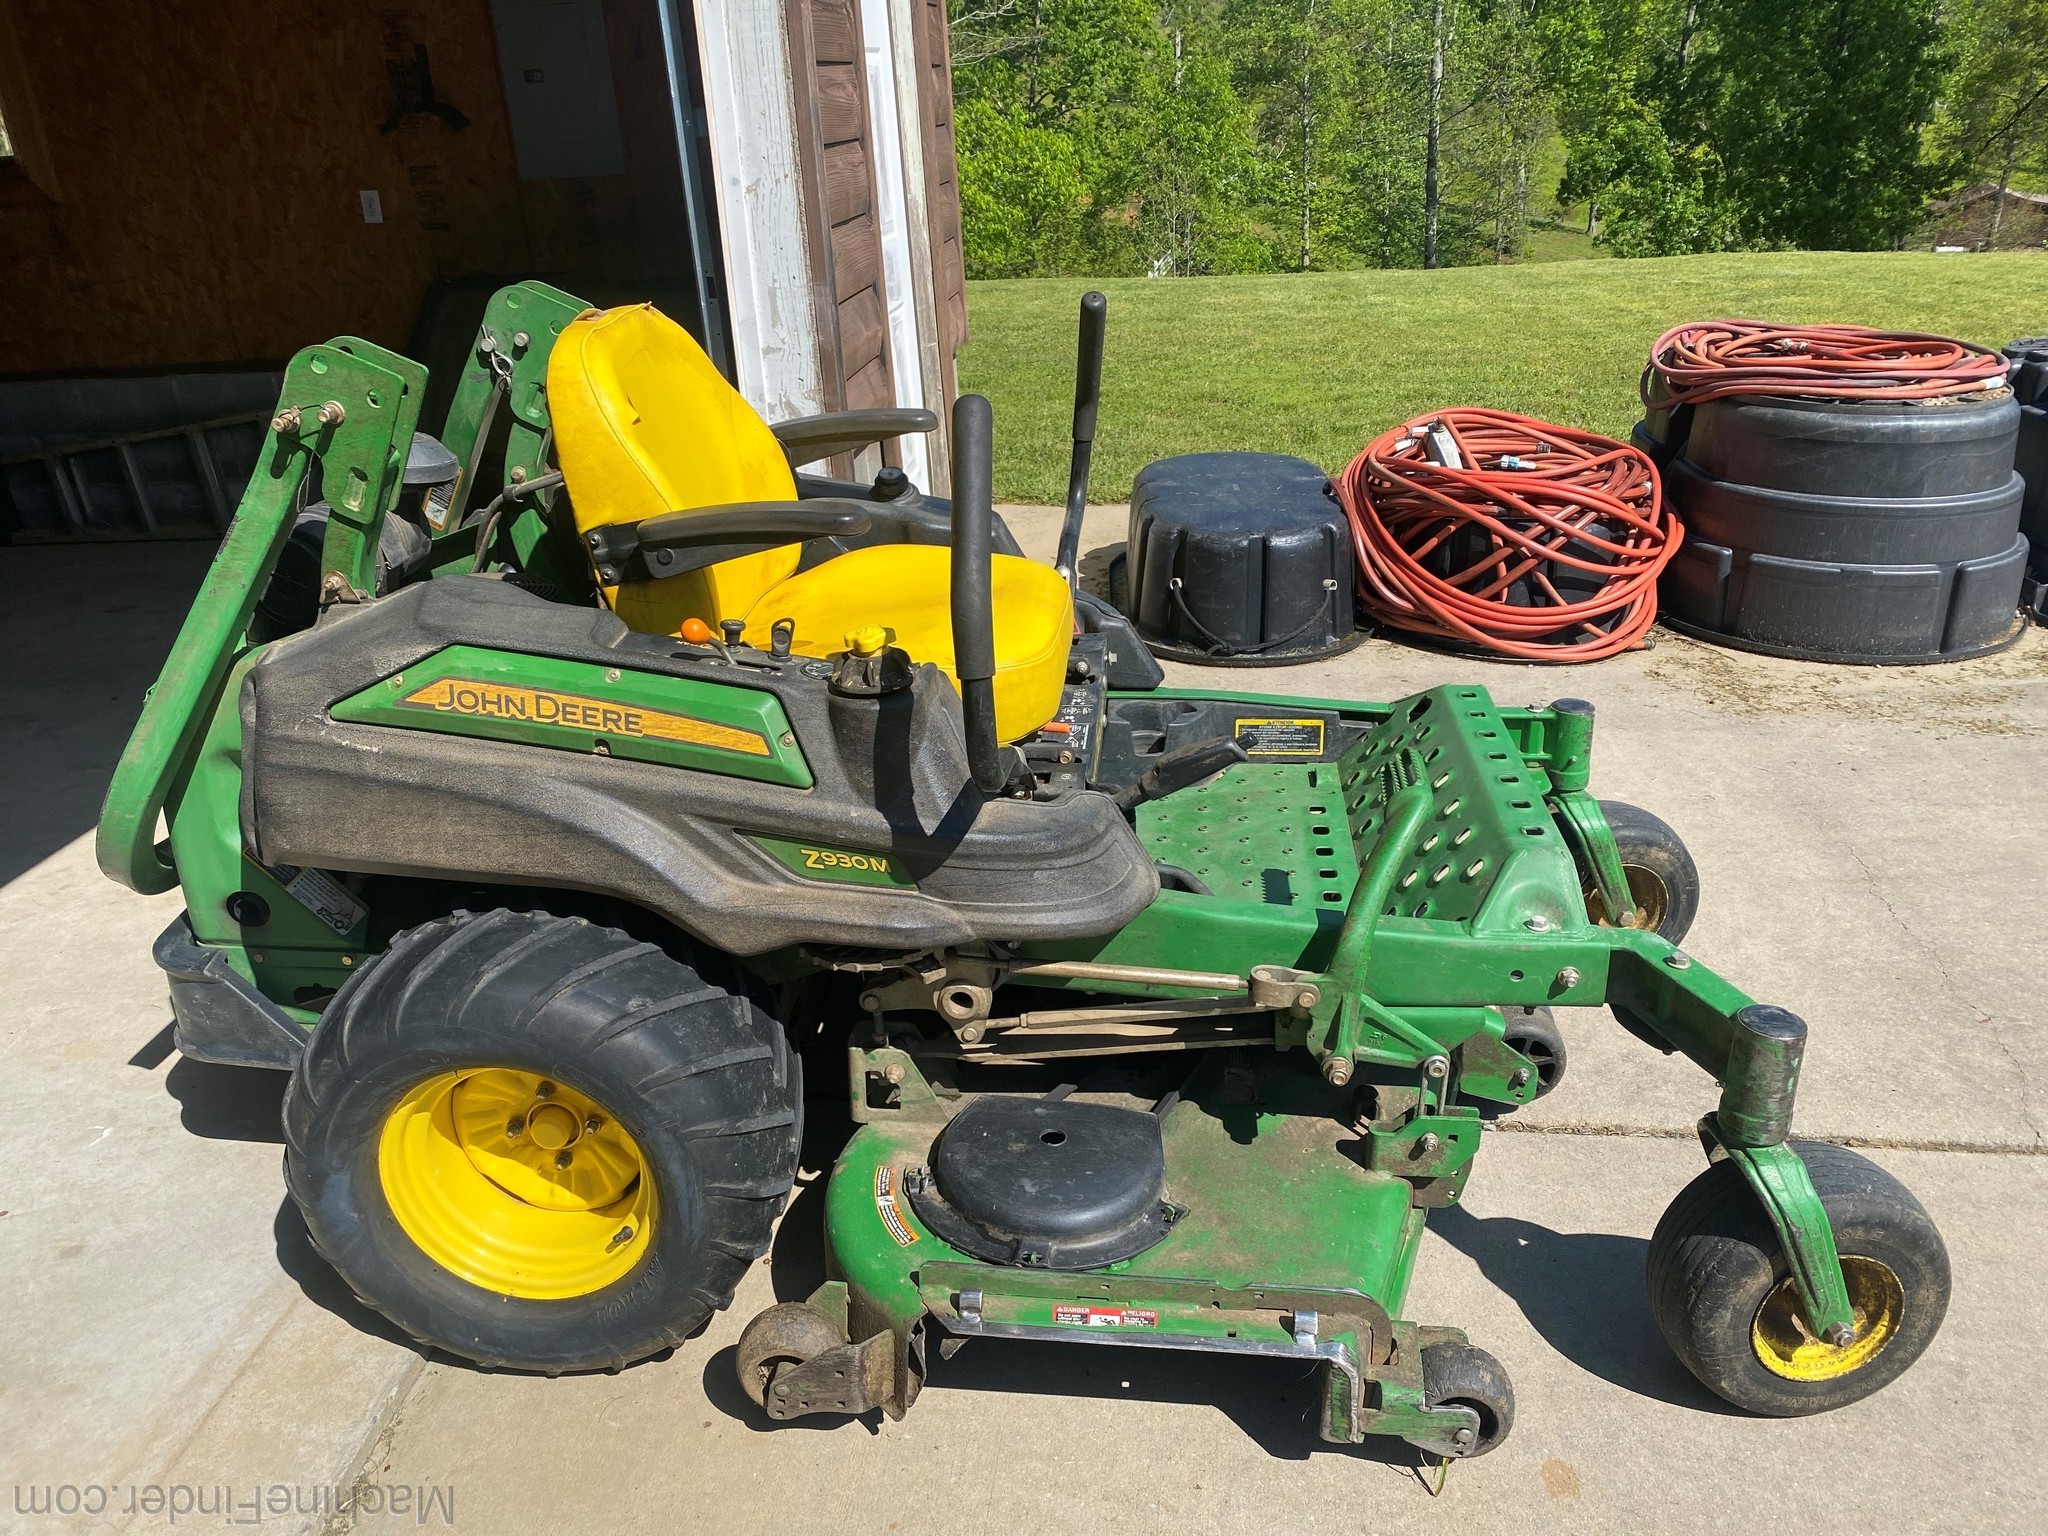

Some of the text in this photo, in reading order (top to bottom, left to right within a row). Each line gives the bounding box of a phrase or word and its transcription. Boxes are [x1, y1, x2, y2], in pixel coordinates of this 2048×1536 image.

[438, 684, 643, 735] JOHN DEERE
[800, 848, 892, 874] Z930M
